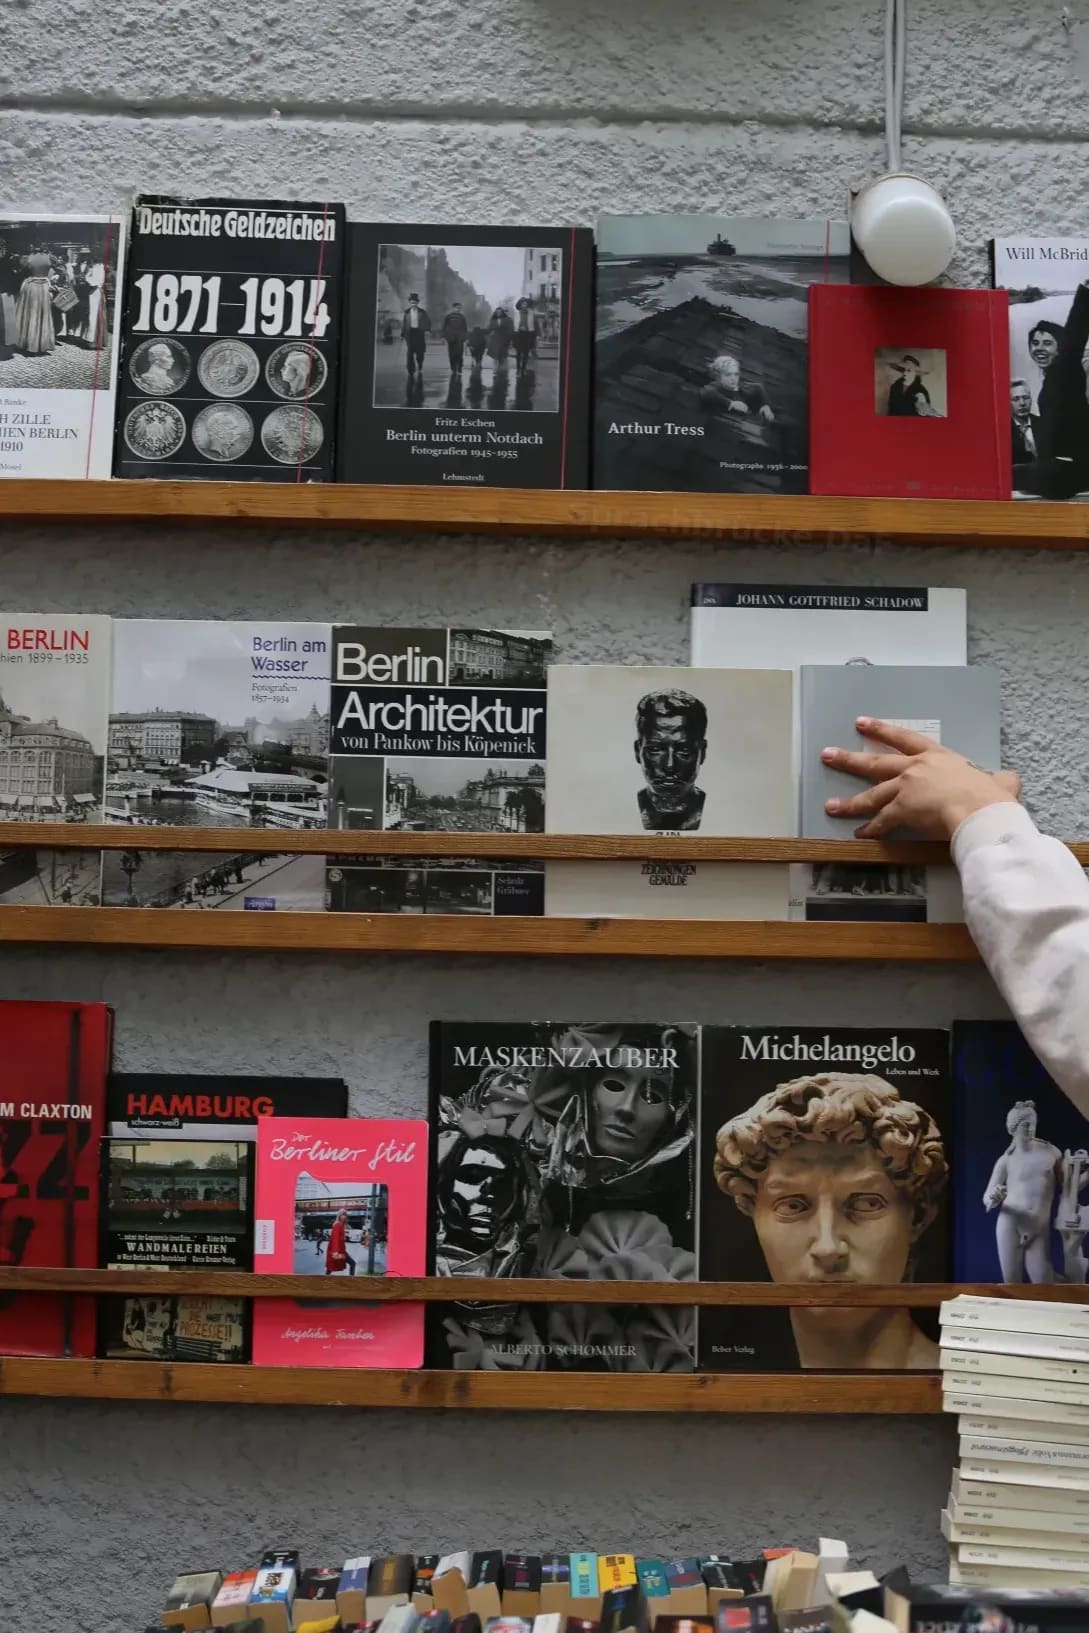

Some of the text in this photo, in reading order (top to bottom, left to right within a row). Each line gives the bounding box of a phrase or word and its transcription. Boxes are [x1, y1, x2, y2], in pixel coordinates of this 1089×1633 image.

[138, 207, 336, 241] Deutsche Geldzeichen
[1006, 247, 1088, 261] Will McBrid
[12, 414, 52, 424] ZILLE
[435, 417, 496, 428] Fritz Eschen
[29, 428, 80, 439] BERLIN
[608, 422, 705, 436] Arthur Tress
[386, 429, 544, 445] Berlin unterm Notdach
[410, 445, 468, 457] Fotografien
[442, 472, 485, 481] Lehmstedt
[736, 594, 924, 608] JOHANN GOTTFRIED SCHADOW
[8, 628, 89, 650] BERLIN
[252, 636, 326, 652] Berlin am
[0, 652, 24, 664] hien
[250, 656, 309, 672] Wasser
[336, 642, 444, 683] Berlin
[252, 682, 298, 694] Fotografien
[336, 690, 544, 734] Architektur
[341, 732, 537, 757] von Pankow bis Köpenick
[640, 864, 697, 876] ZEICHNUNGEN
[452, 1046, 680, 1069] MASKENZAUBER
[740, 1034, 916, 1070] Michelangelo
[886, 1068, 940, 1076] Leben und Werk
[0, 1103, 92, 1120] M CLAXTON
[126, 1094, 275, 1118] HAMBURG
[130, 1118, 180, 1127] schwarz-weiß
[292, 1131, 312, 1142] Der
[270, 1138, 417, 1171] Berliner Stil
[126, 1242, 228, 1254] WANDMALEREIEN
[280, 1327, 330, 1344] Angelika
[491, 1343, 638, 1357] ALBERTO SCHOMMER
